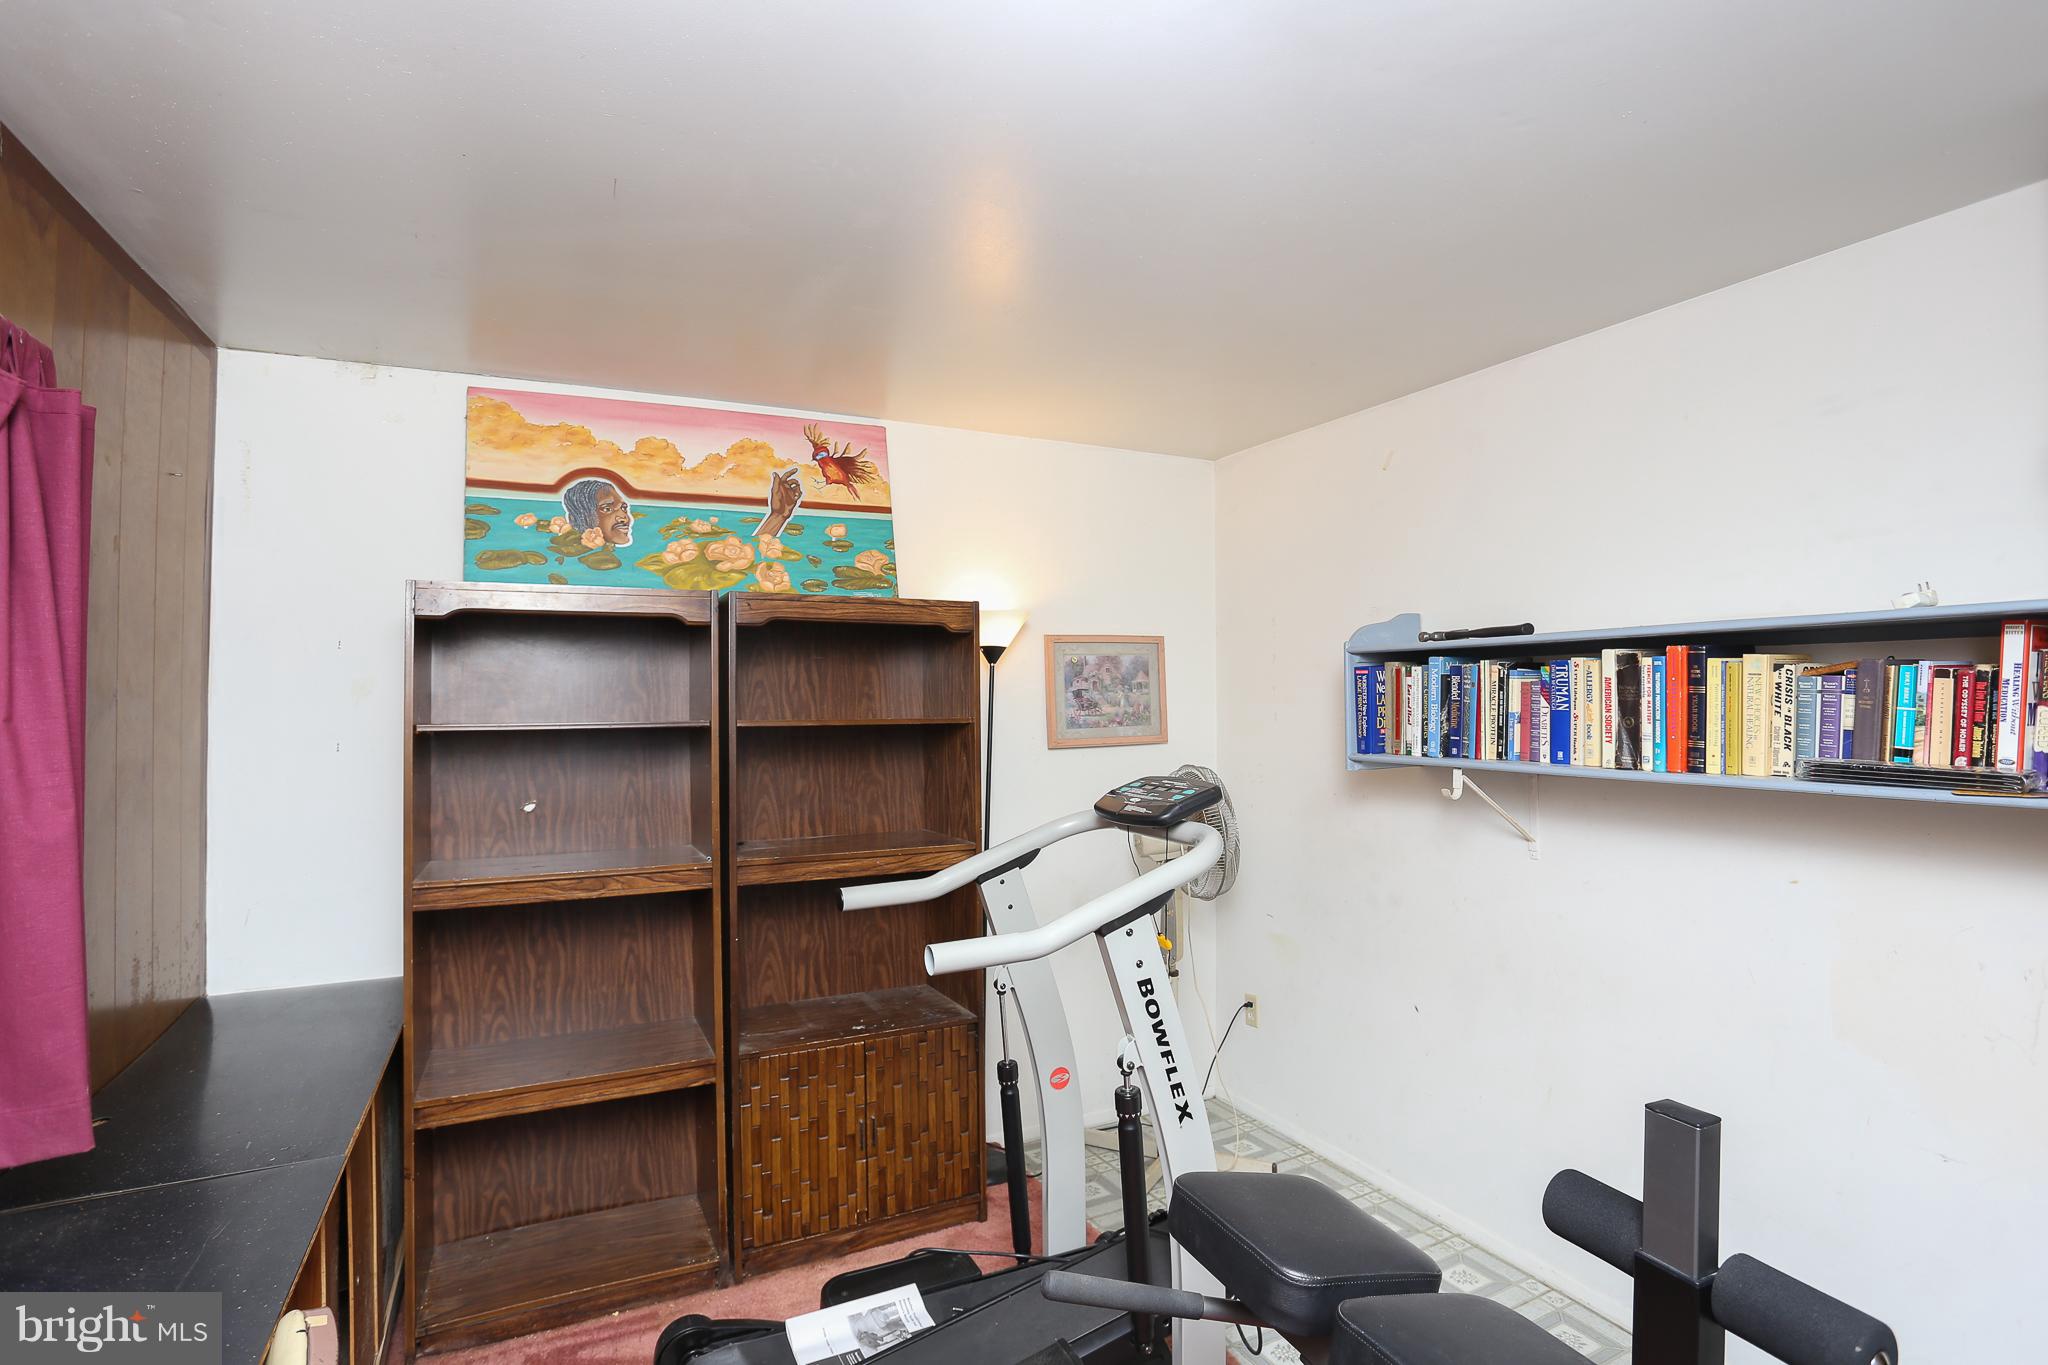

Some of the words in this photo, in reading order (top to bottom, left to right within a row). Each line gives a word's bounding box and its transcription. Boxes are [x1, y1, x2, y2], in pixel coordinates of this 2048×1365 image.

[1431, 668, 1439, 701] Modern
[1451, 675, 1461, 701] Blended
[1556, 664, 1569, 711] TRUMAN
[1604, 676, 1612, 714] AMERICAN
[1784, 668, 1794, 706] CRISIS
[2012, 663, 2022, 698] HEALING
[1774, 681, 1783, 718] WHITE
[2000, 678, 2010, 723] MEDICATION
[2010, 698, 2021, 736] Without
[1429, 703, 1438, 734] Biology
[1604, 714, 1613, 744] SOCIETY
[1783, 714, 1793, 752] BLACK
[1960, 718, 1967, 728] OF
[1958, 728, 1967, 752] HOMER
[1136, 977, 1194, 1124] BOWFLEX
